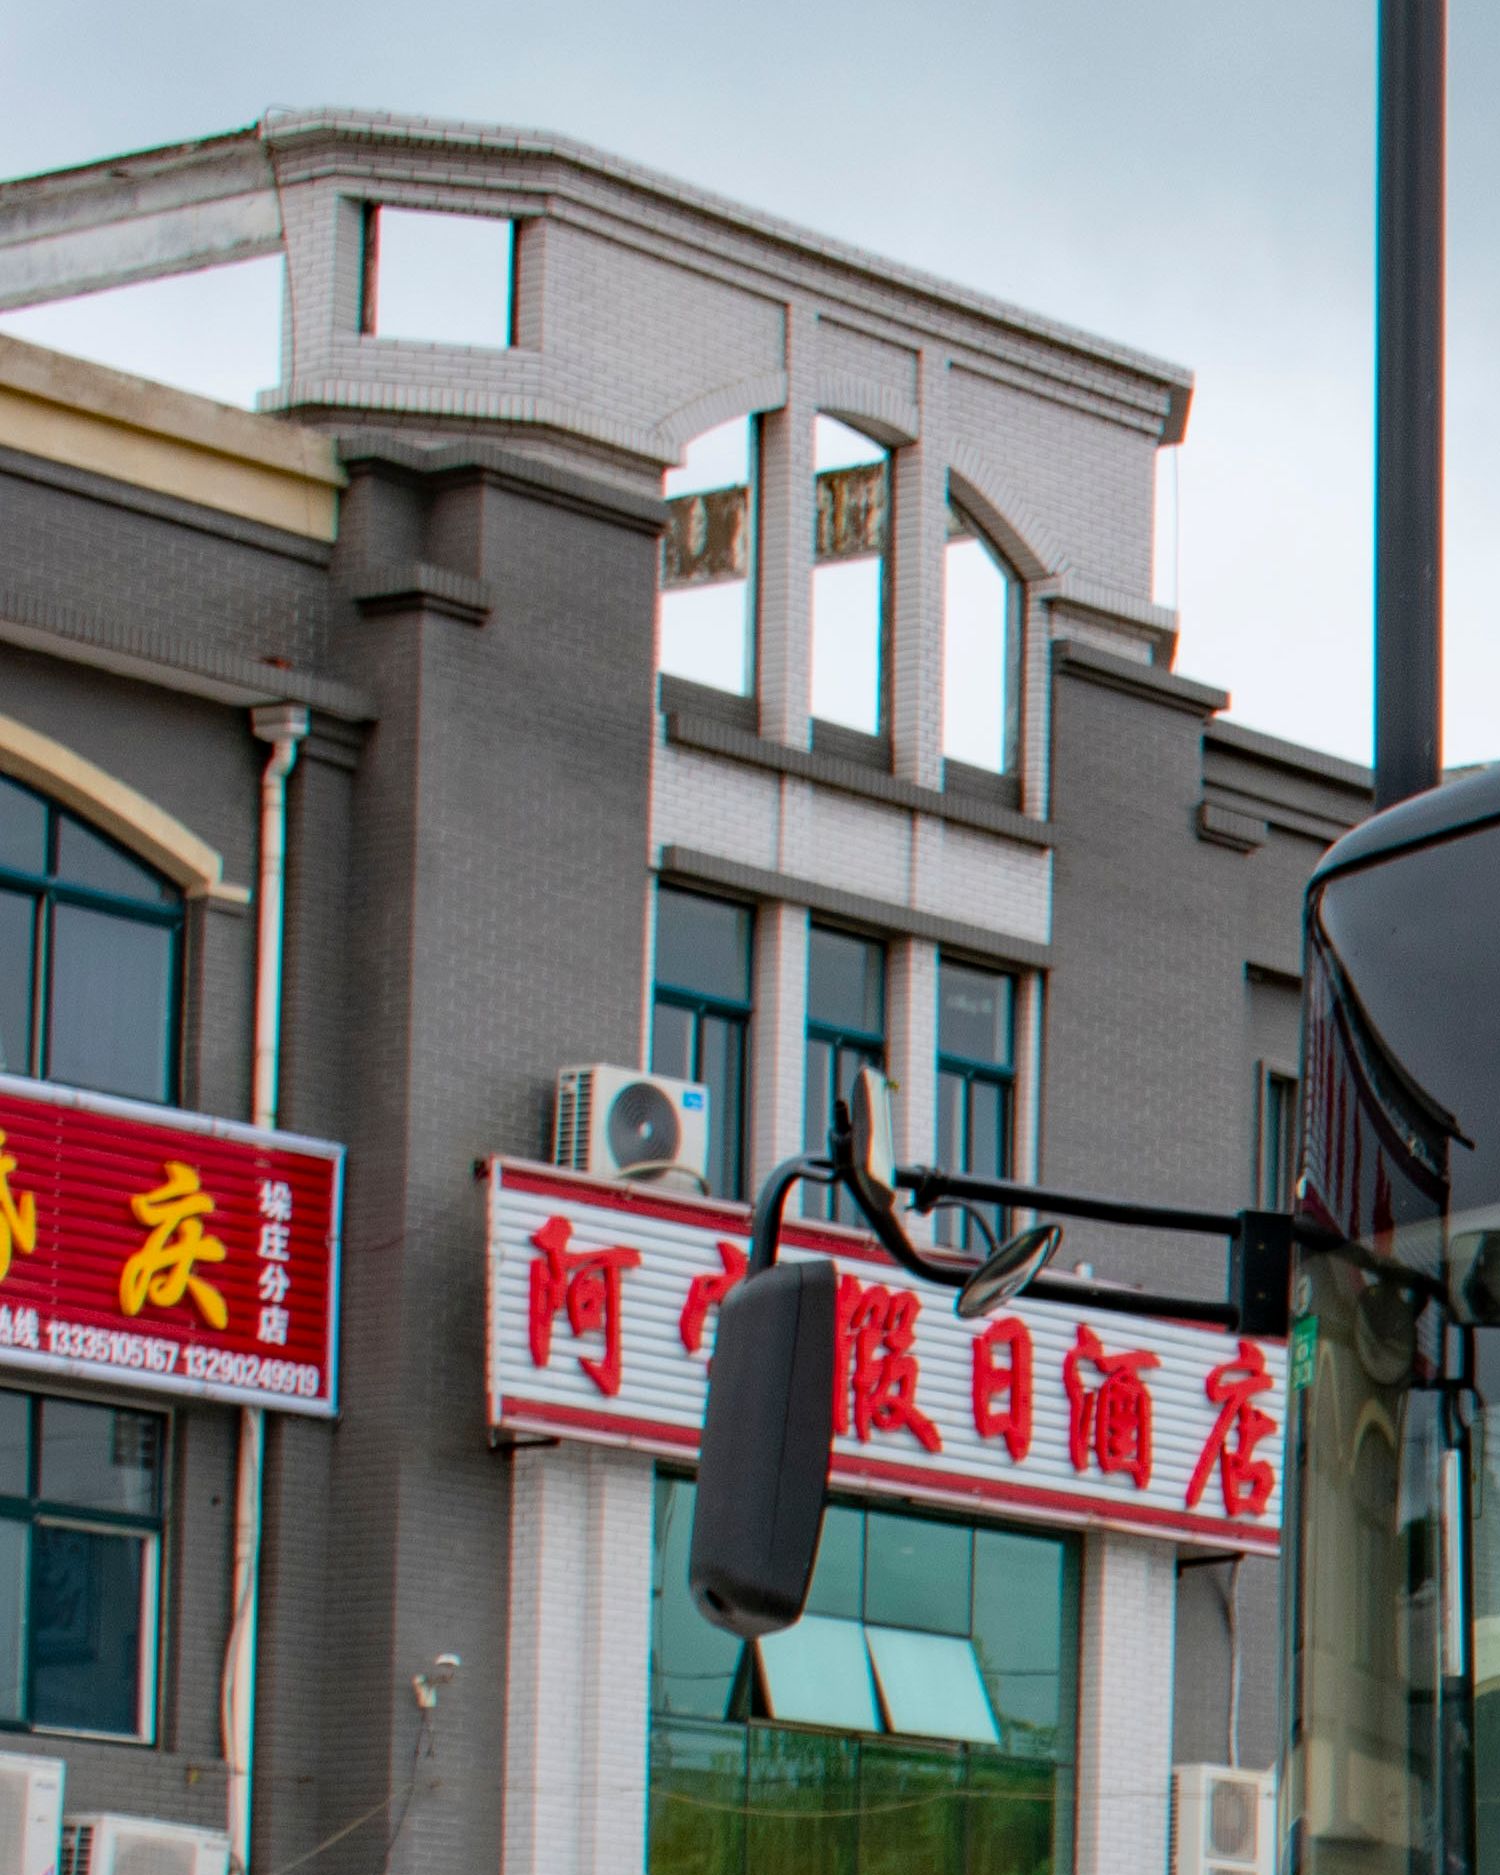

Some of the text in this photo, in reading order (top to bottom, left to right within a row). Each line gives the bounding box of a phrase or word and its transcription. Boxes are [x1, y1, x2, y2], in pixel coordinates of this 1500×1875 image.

[257, 1181, 292, 1346] 垛庄分店
[529, 1216, 1277, 1518] 阿假日酒店
